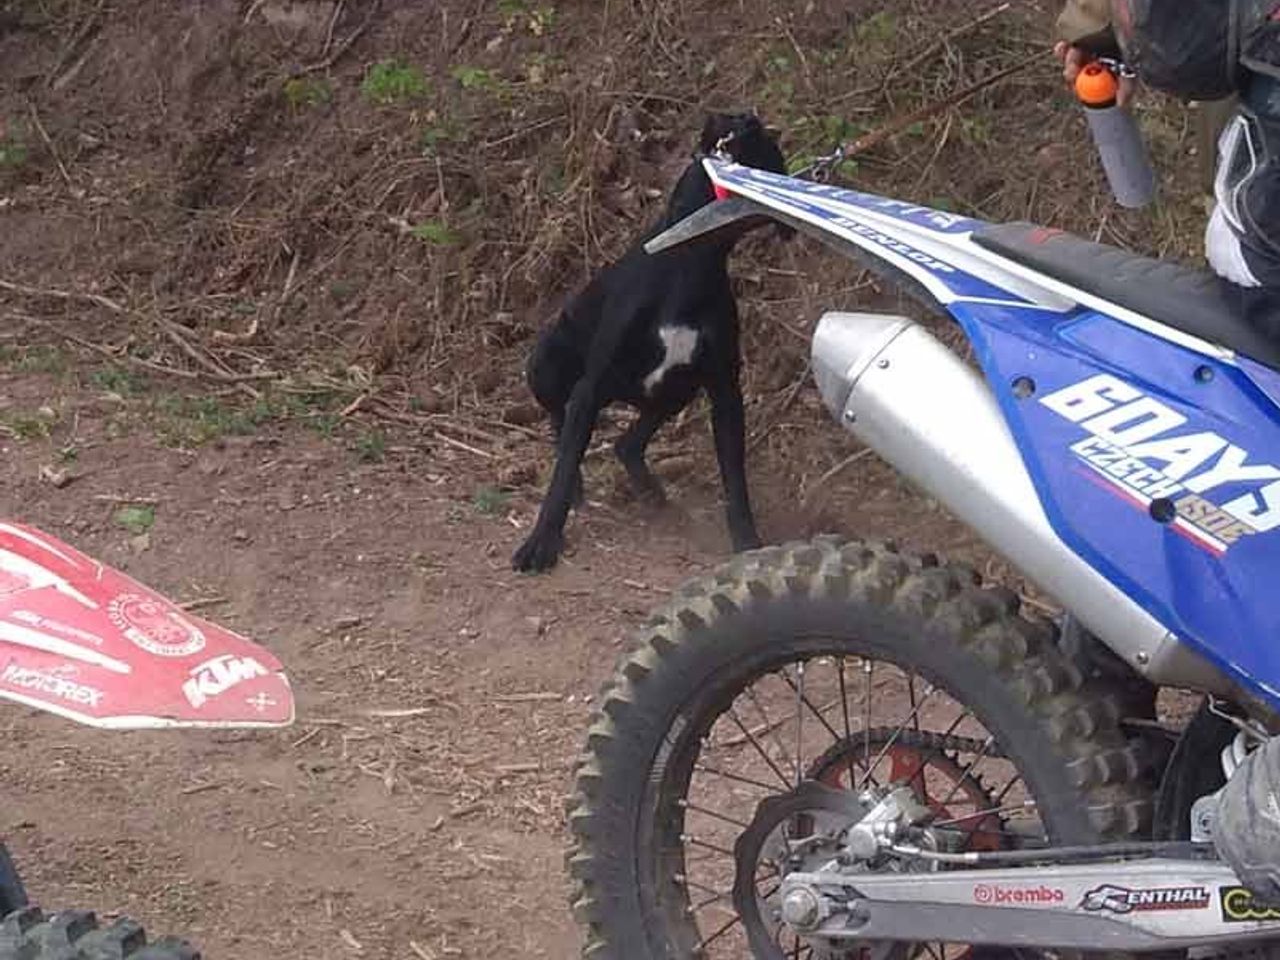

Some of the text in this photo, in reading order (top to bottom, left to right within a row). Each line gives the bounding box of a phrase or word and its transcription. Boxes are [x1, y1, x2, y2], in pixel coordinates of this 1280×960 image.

[828, 216, 957, 274] DUNLOP
[1069, 435, 1188, 500] CZECH
[181, 654, 269, 709] KTM
[995, 885, 1065, 904] brembo
[1078, 883, 1212, 915] RENTHAL
